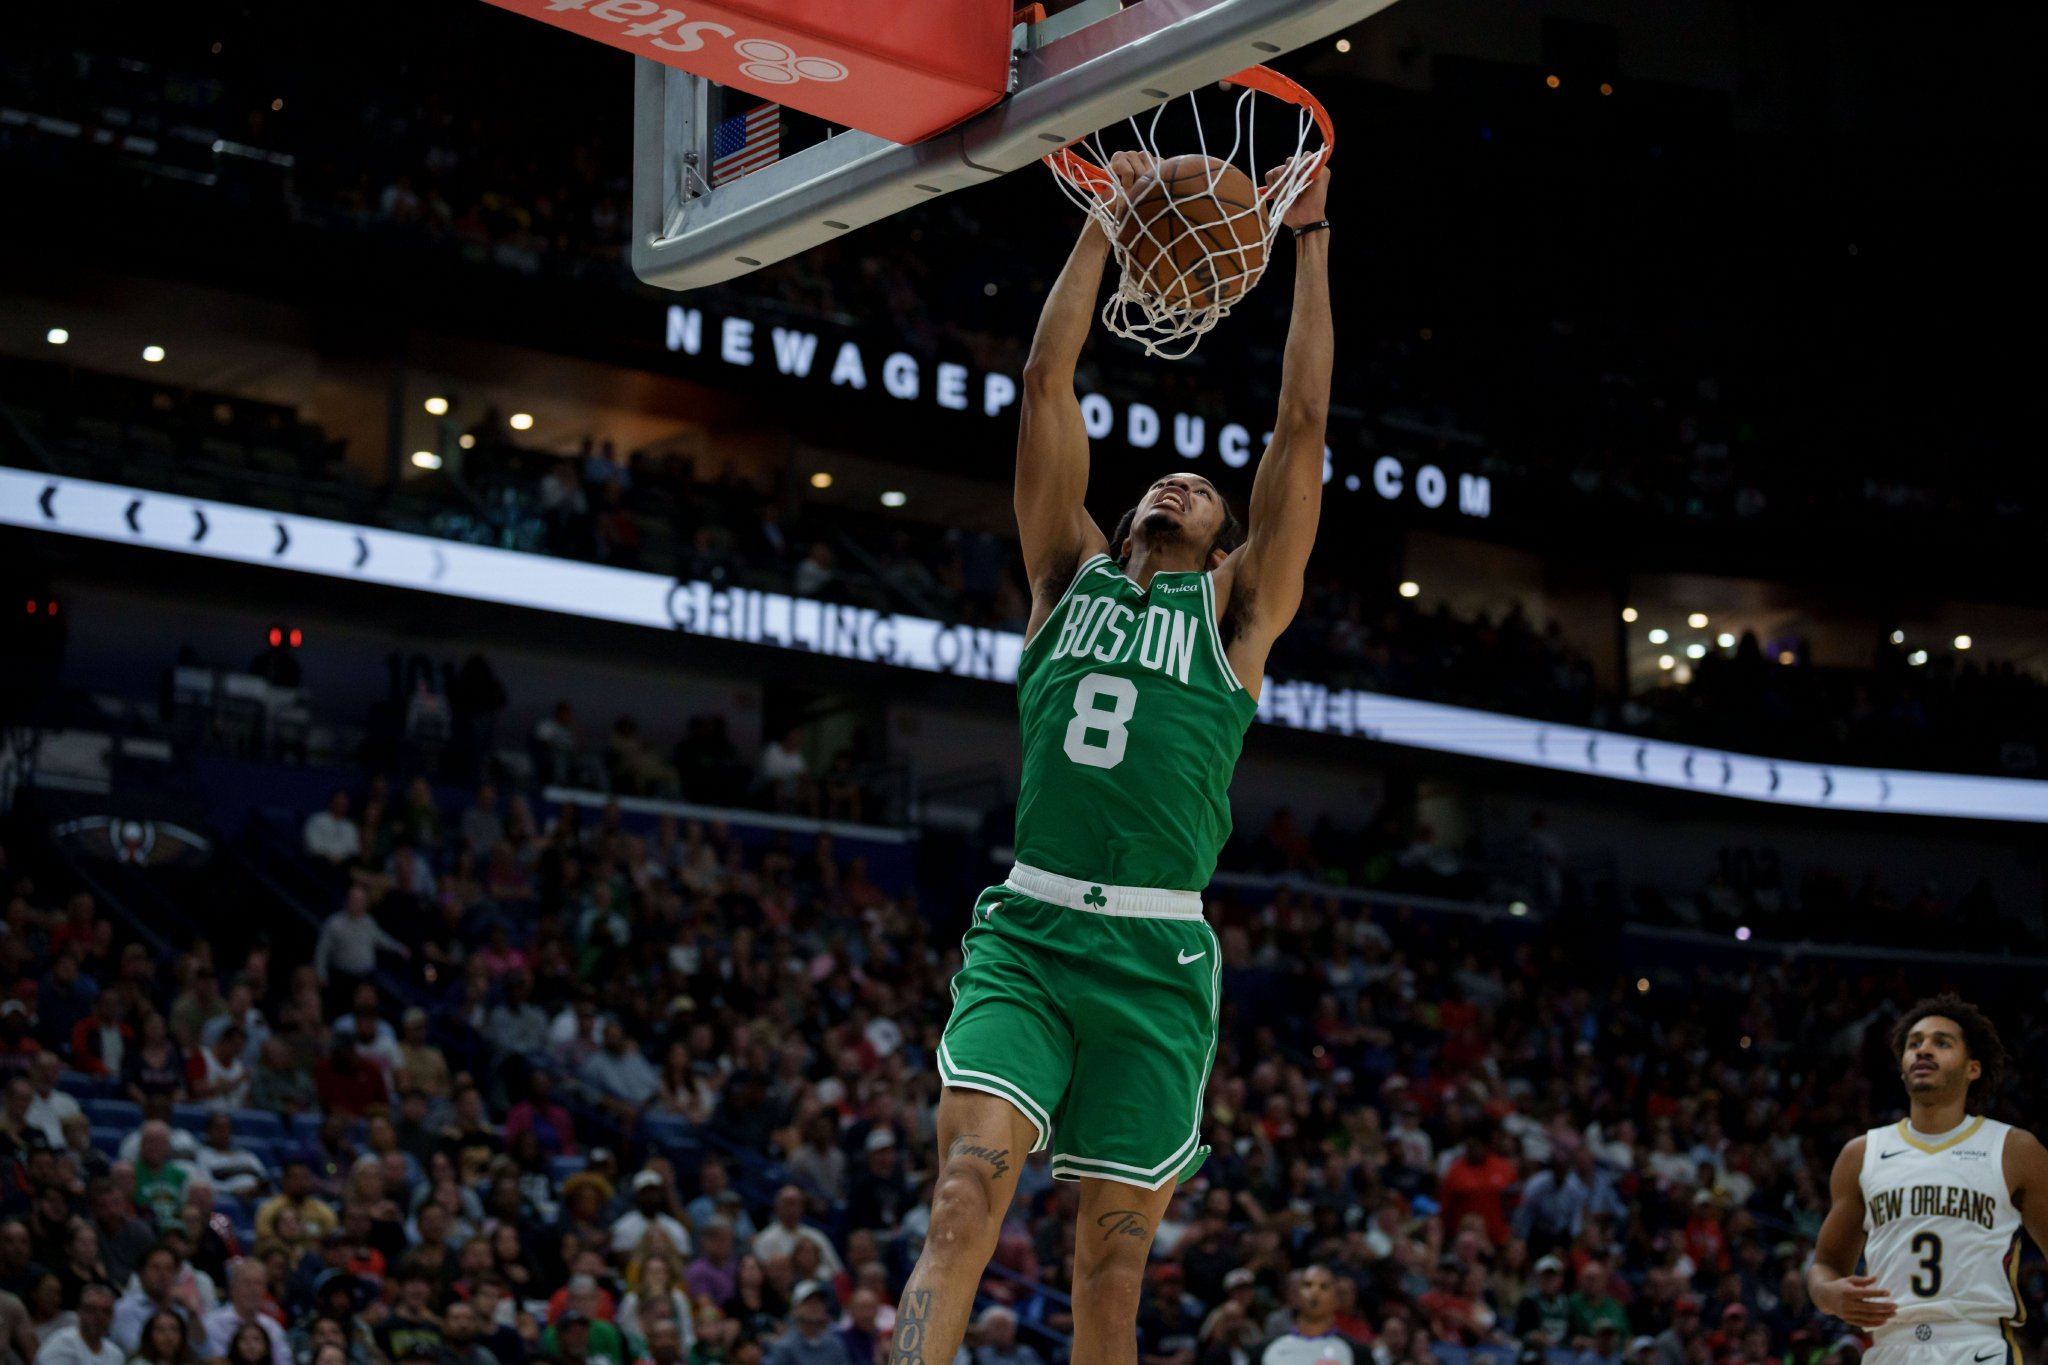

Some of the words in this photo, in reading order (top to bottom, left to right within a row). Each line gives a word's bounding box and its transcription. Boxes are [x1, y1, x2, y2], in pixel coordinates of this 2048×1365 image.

[666, 305, 1491, 518] NEWAGEPODUC.COM
[1156, 583, 1198, 594] Amica
[933, 620, 998, 681] ON
[1063, 672, 1139, 770] 8
[1869, 1187, 1904, 1229] NEW
[1911, 1185, 1996, 1230] ORLEANS
[1910, 1230, 1943, 1299] 3
